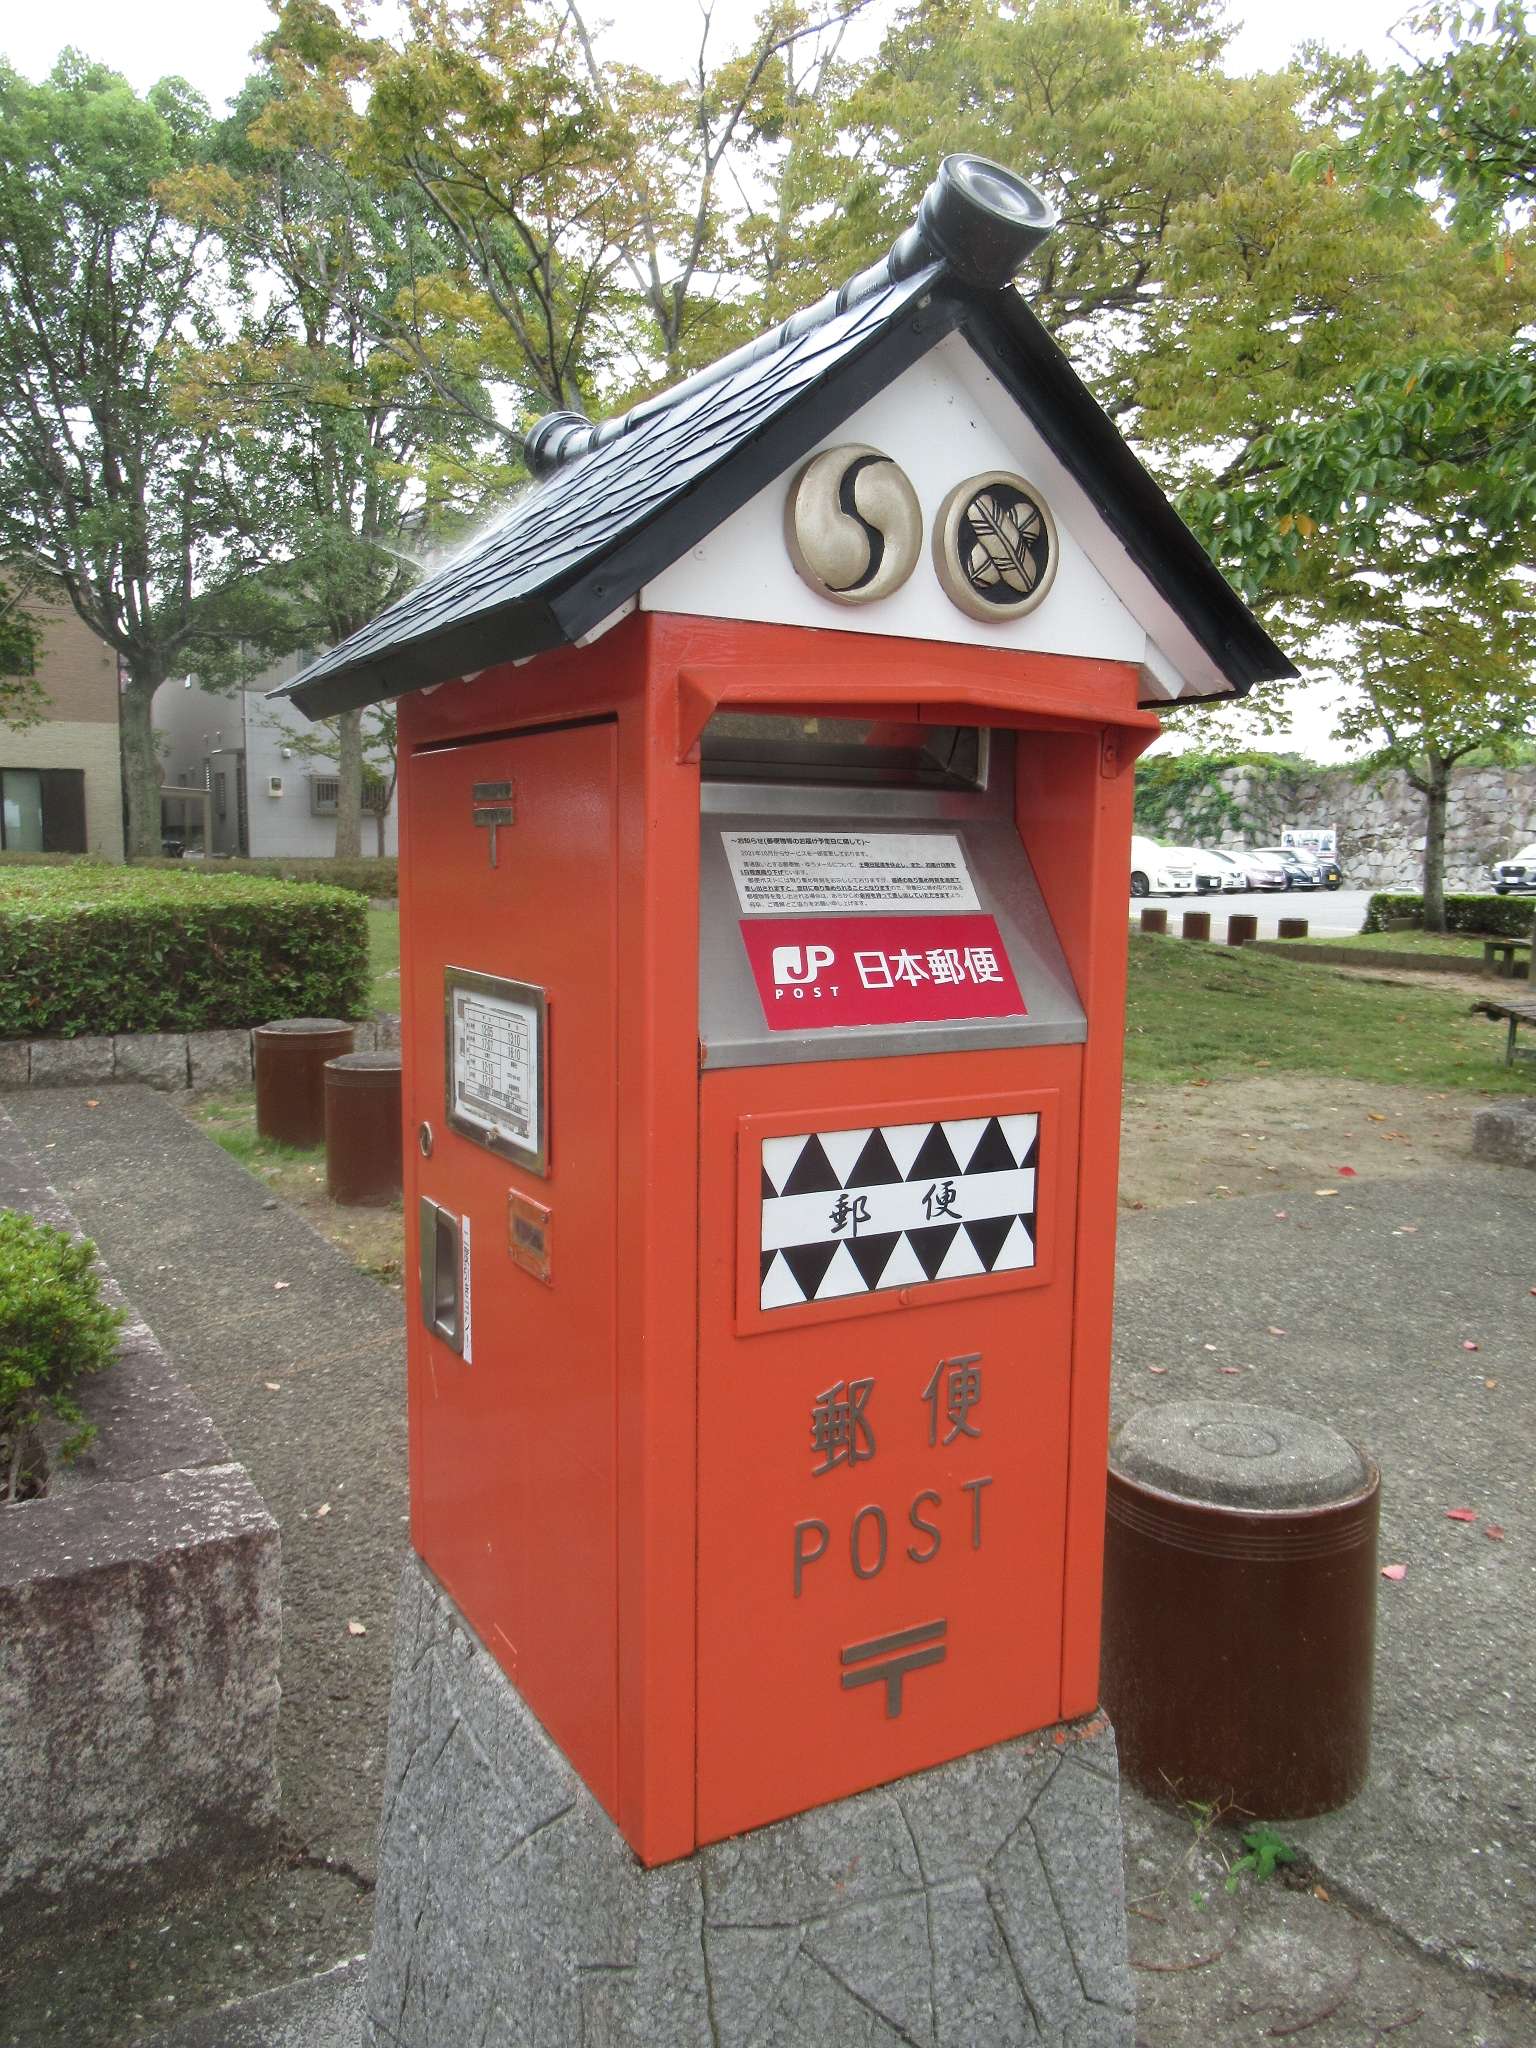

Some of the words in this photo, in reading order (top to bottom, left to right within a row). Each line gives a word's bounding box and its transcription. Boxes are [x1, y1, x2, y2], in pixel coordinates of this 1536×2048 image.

[775, 986, 839, 999] POST
[853, 947, 1004, 989] 日本郵便
[828, 1180, 963, 1238] 郵便
[811, 1352, 983, 1477] 郵便
[794, 1476, 993, 1599] POST
